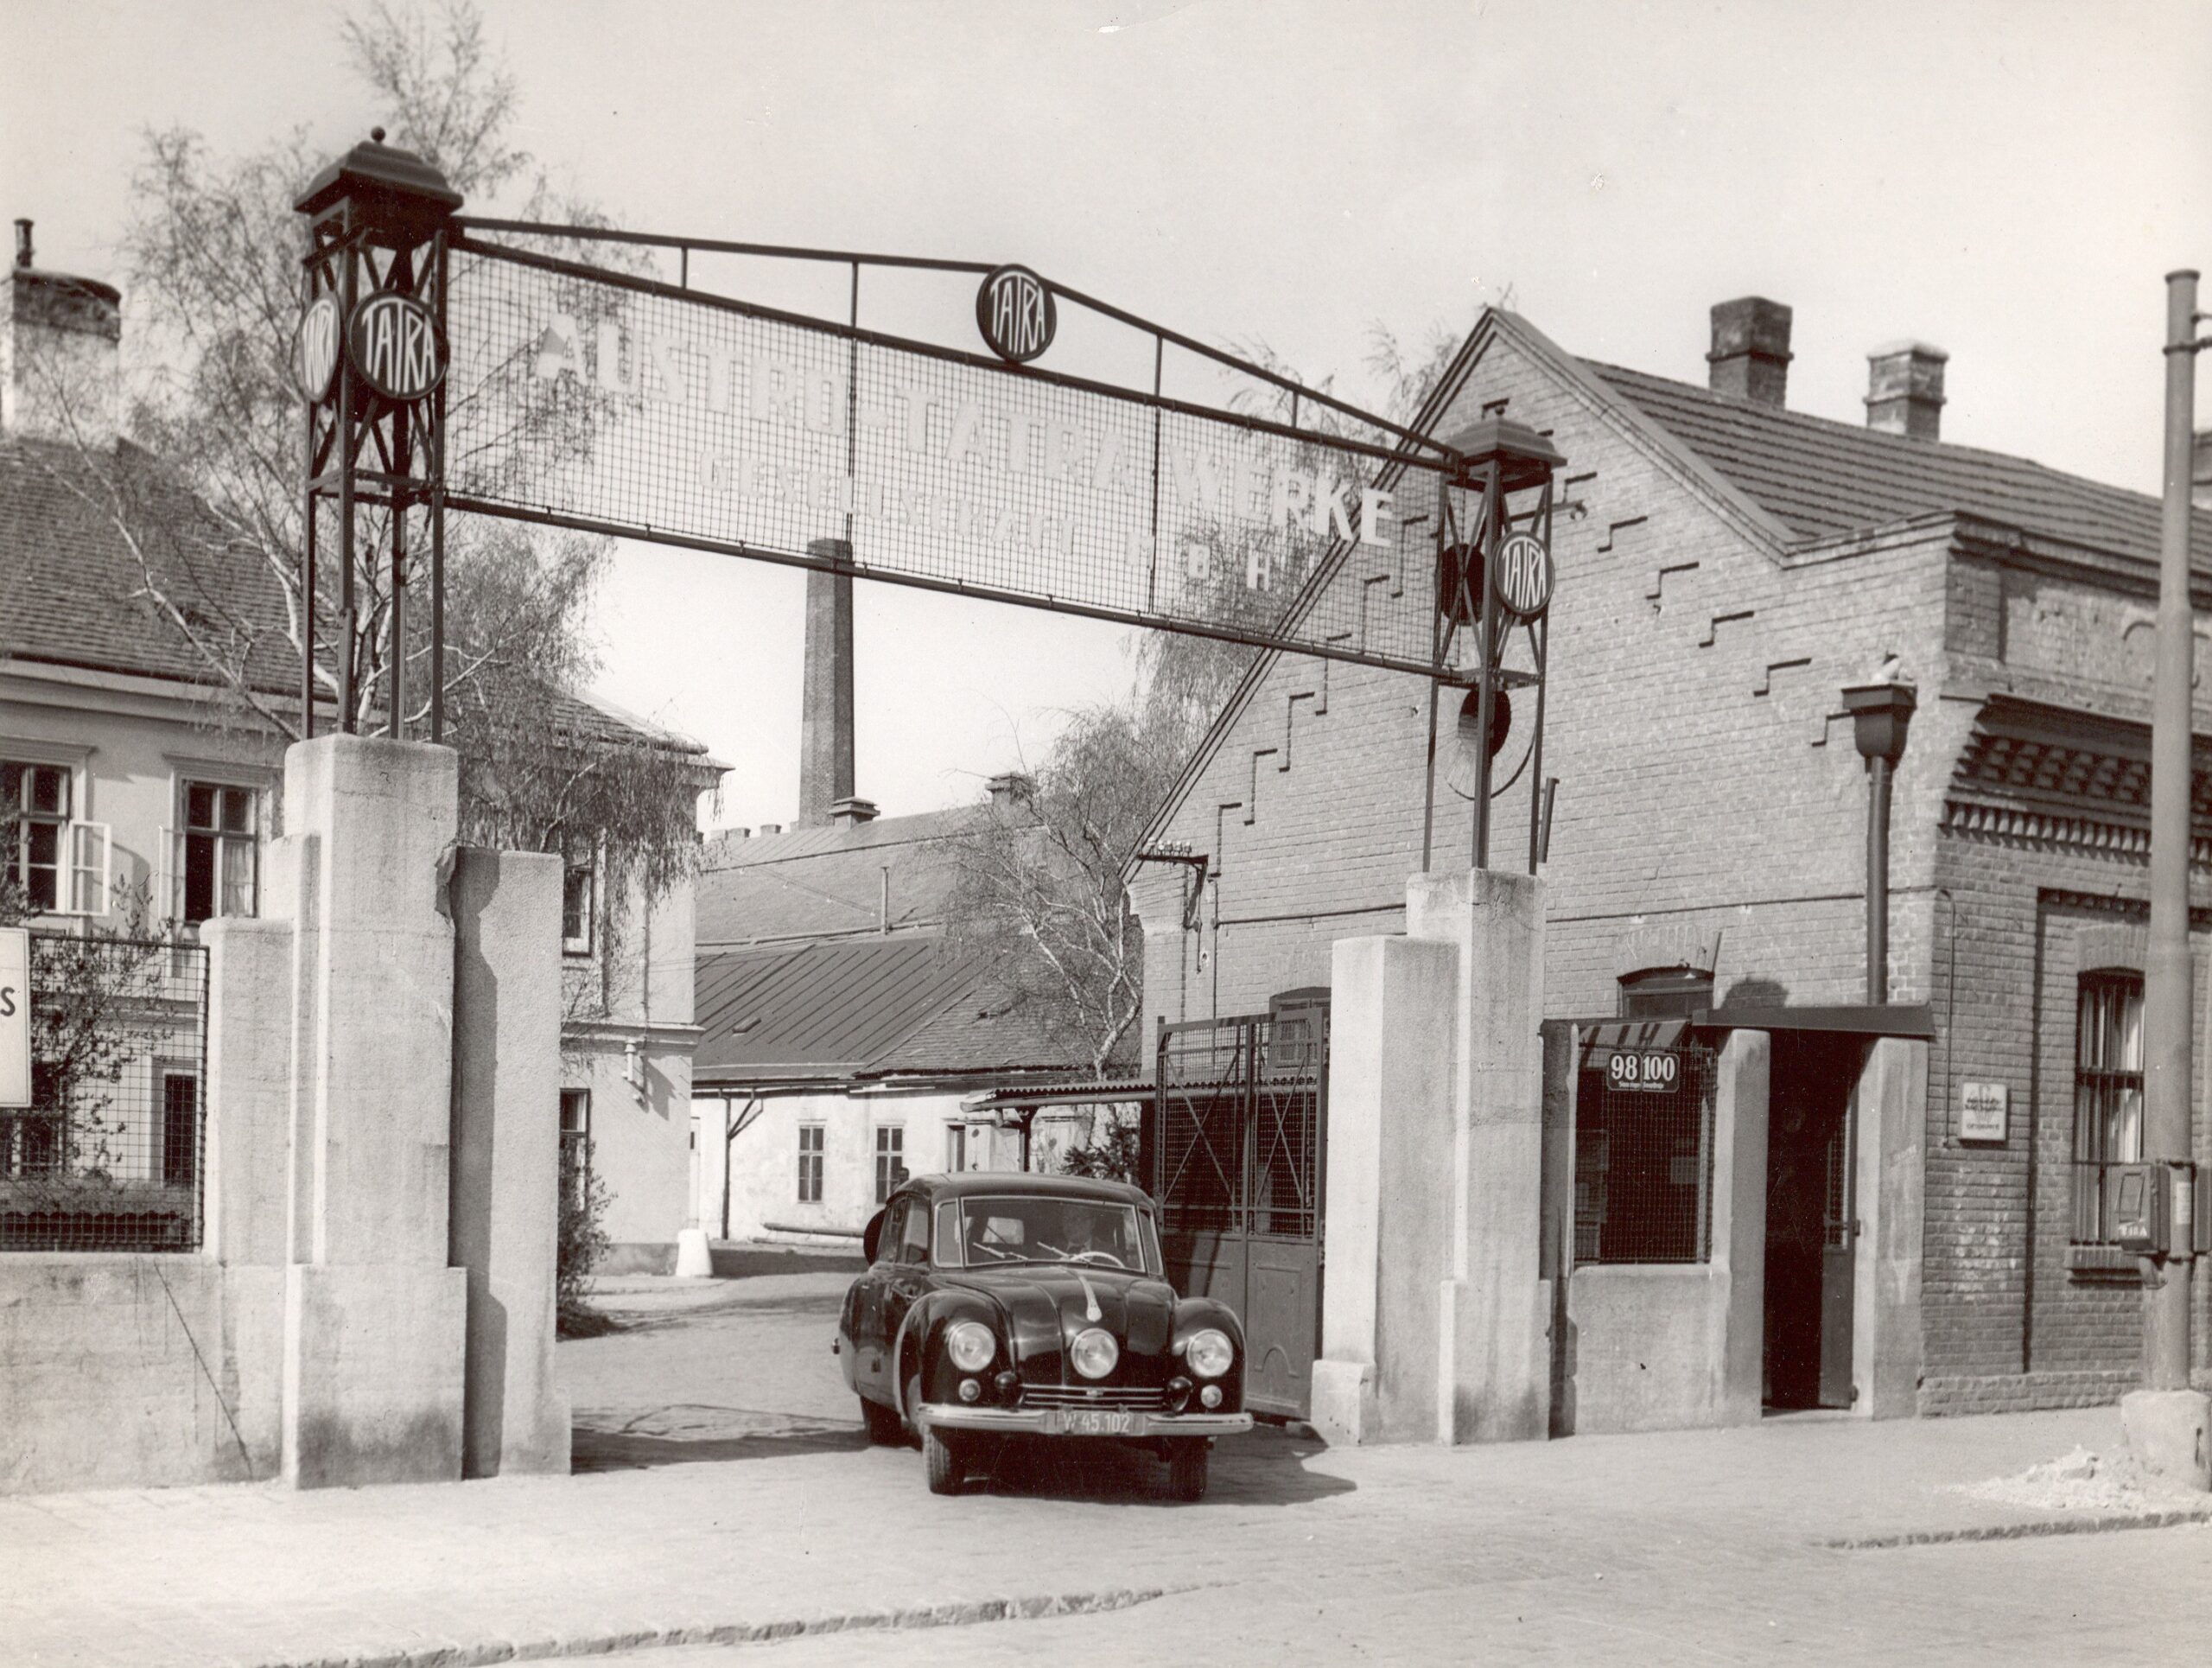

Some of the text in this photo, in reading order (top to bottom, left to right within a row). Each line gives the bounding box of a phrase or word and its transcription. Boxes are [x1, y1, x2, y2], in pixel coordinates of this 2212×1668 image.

[361, 296, 436, 394] TATRA
[990, 270, 1046, 354] TATRA
[1167, 440, 1394, 547] WERKE
[1503, 535, 1547, 610] TATRA
[1611, 1054, 1675, 1082] 98 100
[1081, 1412, 1131, 1434] 45.102
